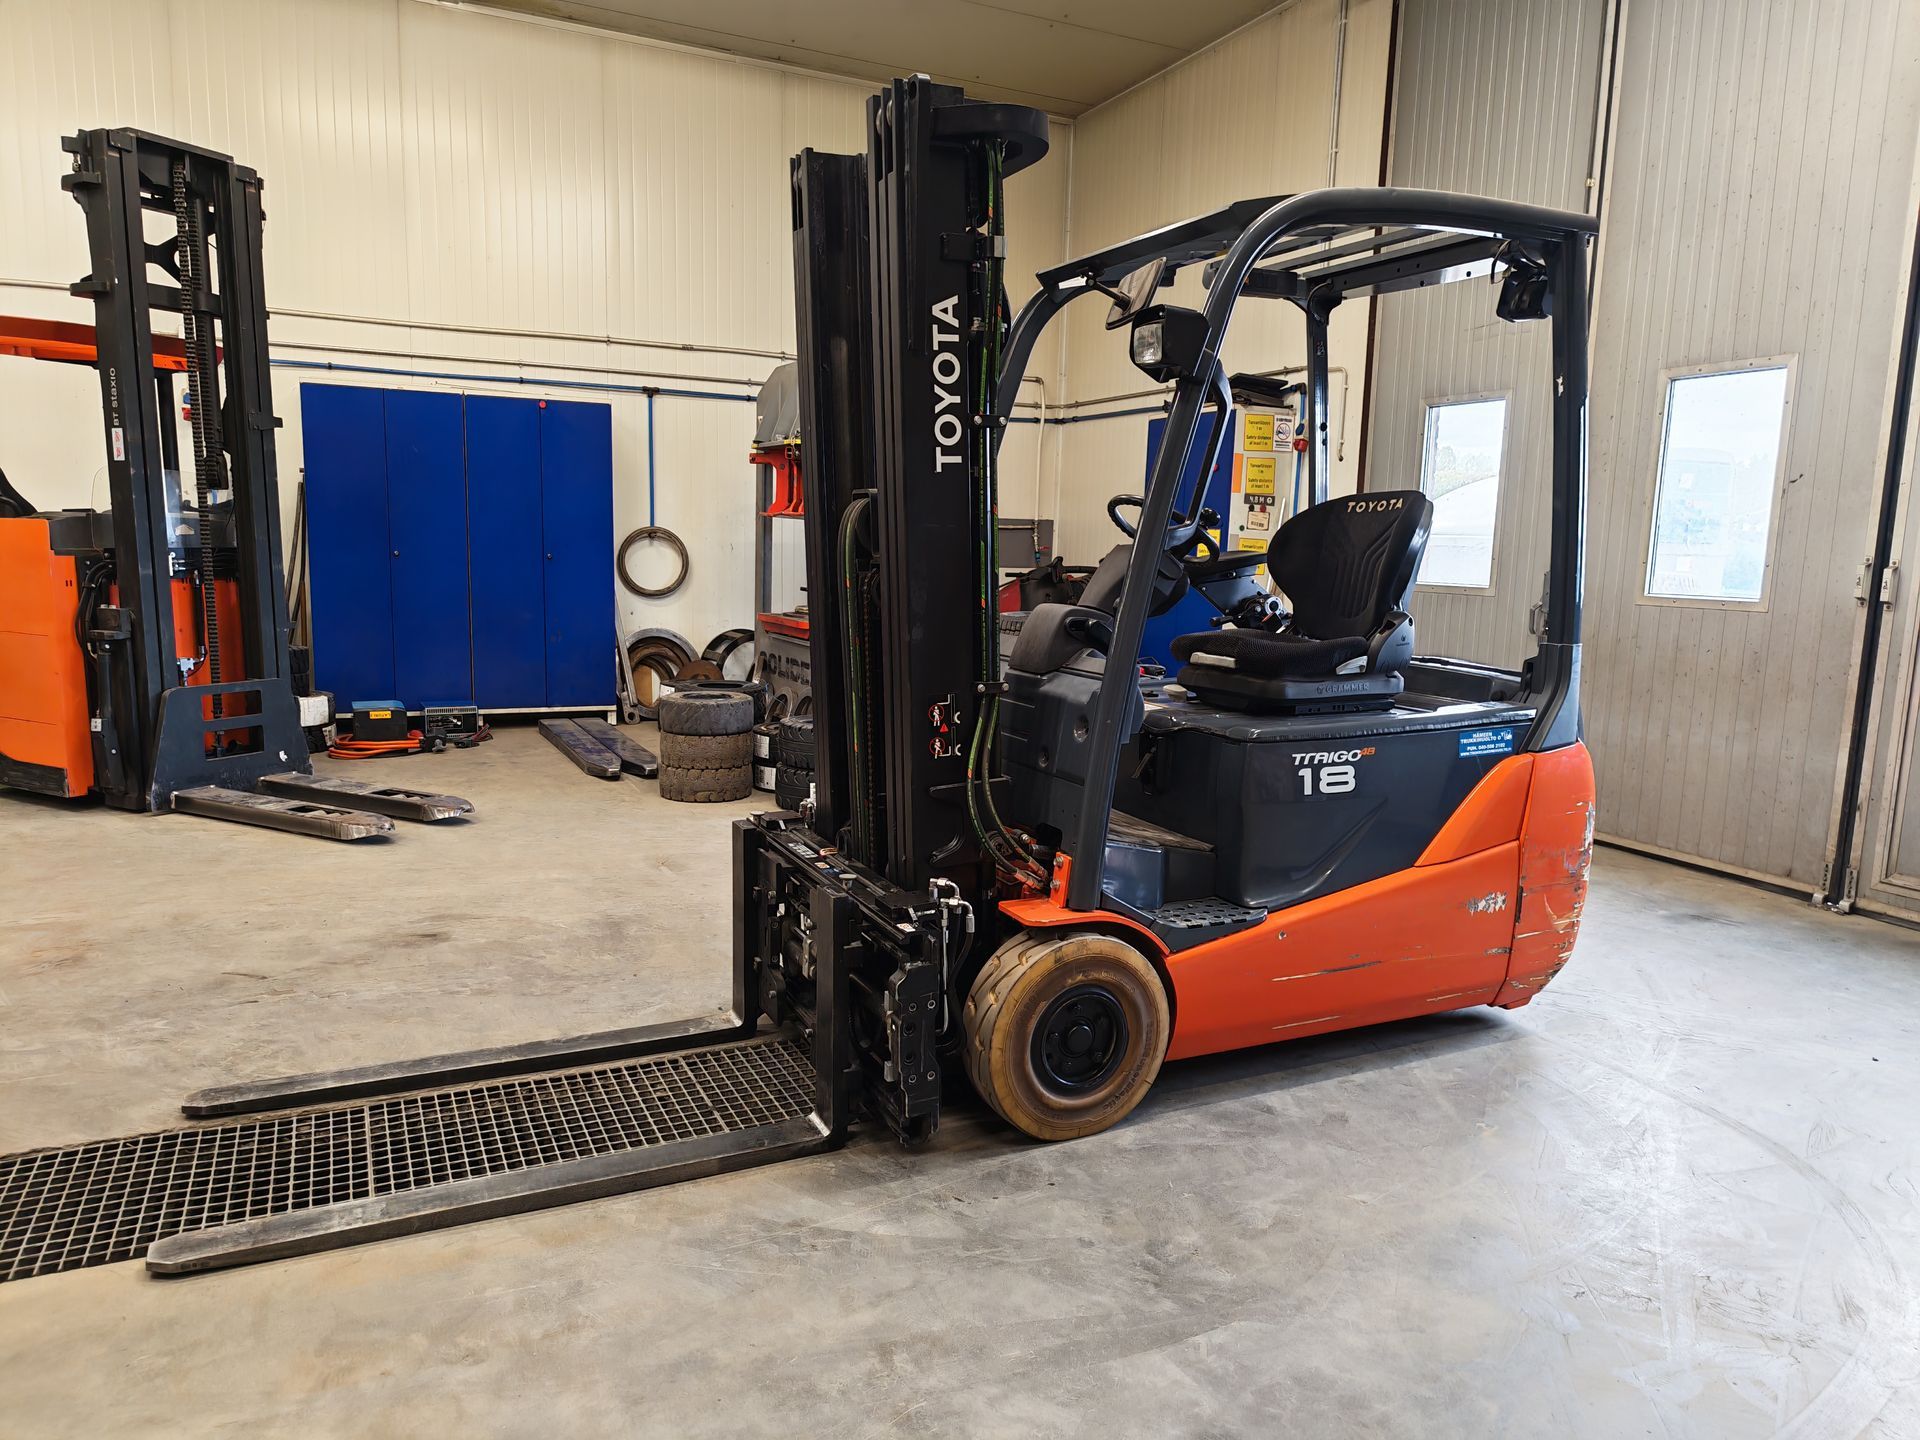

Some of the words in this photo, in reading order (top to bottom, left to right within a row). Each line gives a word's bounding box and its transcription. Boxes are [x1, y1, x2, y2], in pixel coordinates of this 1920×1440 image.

[932, 294, 962, 473] TOYOTA
[113, 412, 119, 426] BT
[1347, 498, 1403, 513] TOYOTA
[1326, 682, 1369, 694] GRAMMER
[1298, 765, 1356, 796] 18
